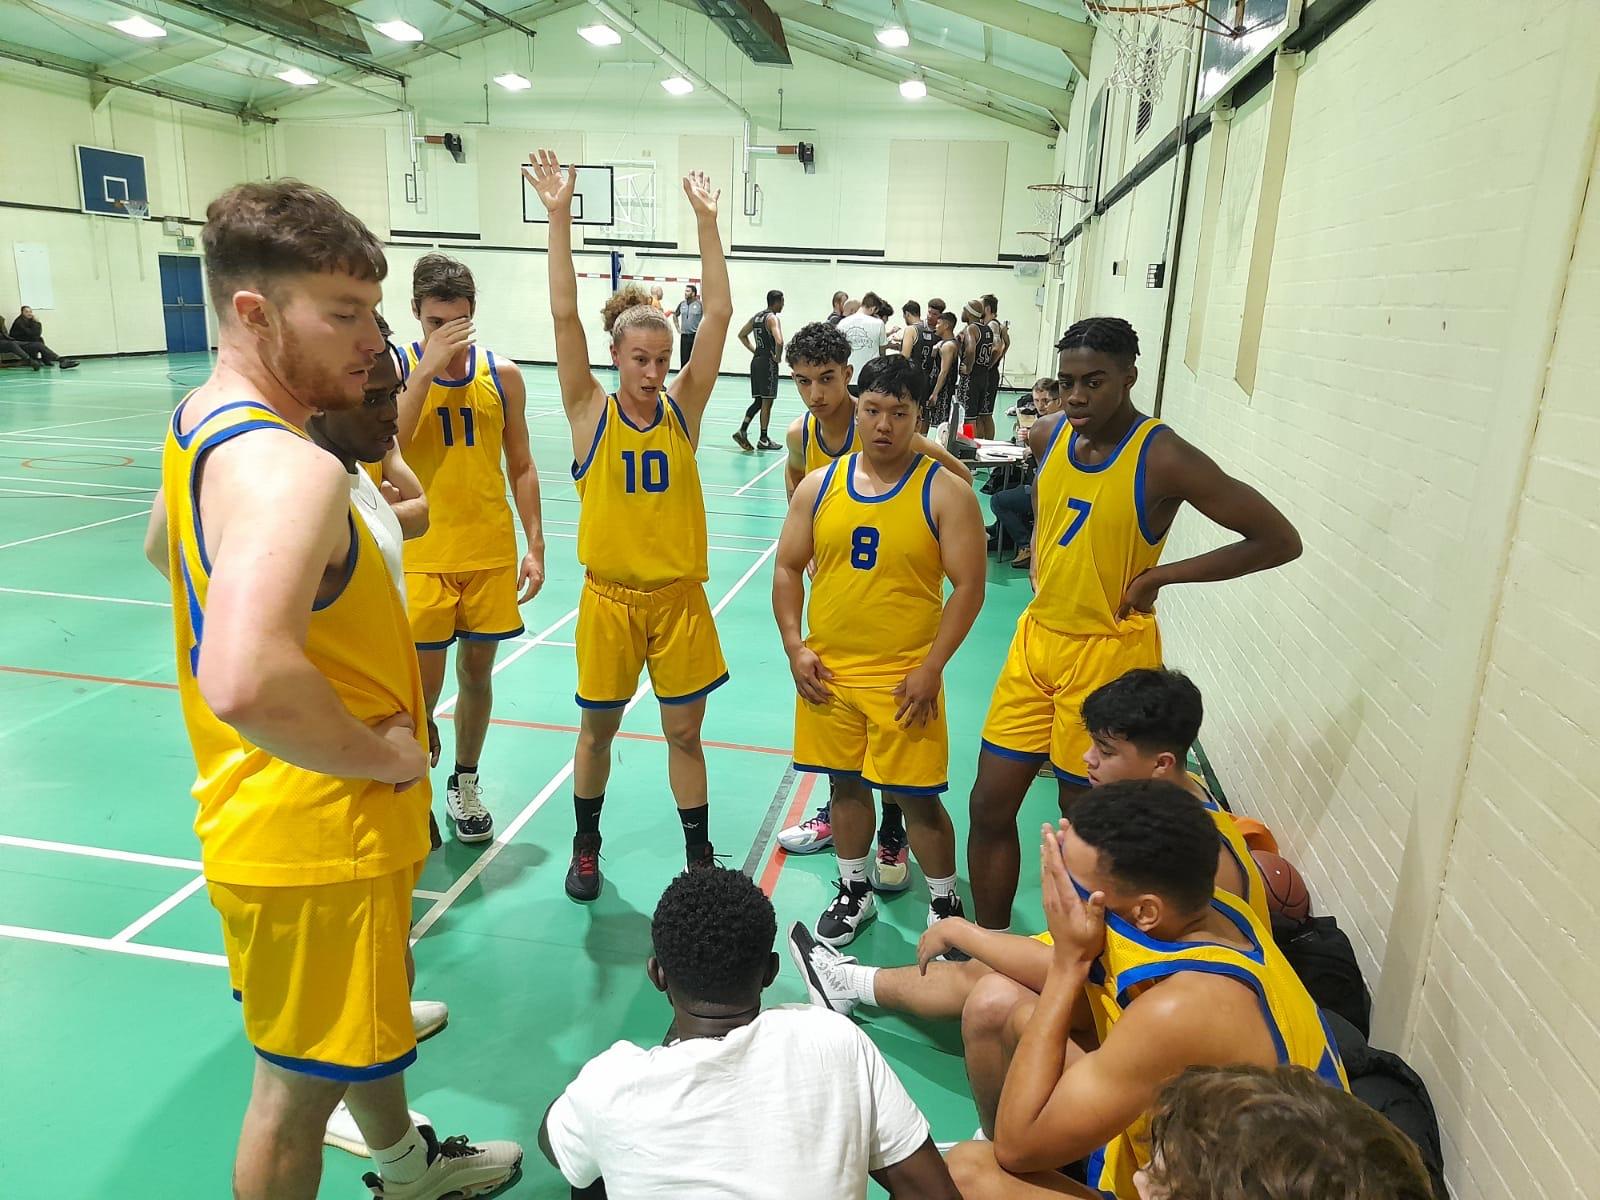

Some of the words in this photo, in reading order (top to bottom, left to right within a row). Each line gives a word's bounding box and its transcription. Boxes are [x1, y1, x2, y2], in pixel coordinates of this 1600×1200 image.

[437, 407, 475, 447] 11
[621, 450, 670, 493] 10
[1057, 497, 1092, 548] 7
[850, 526, 880, 571] 8
